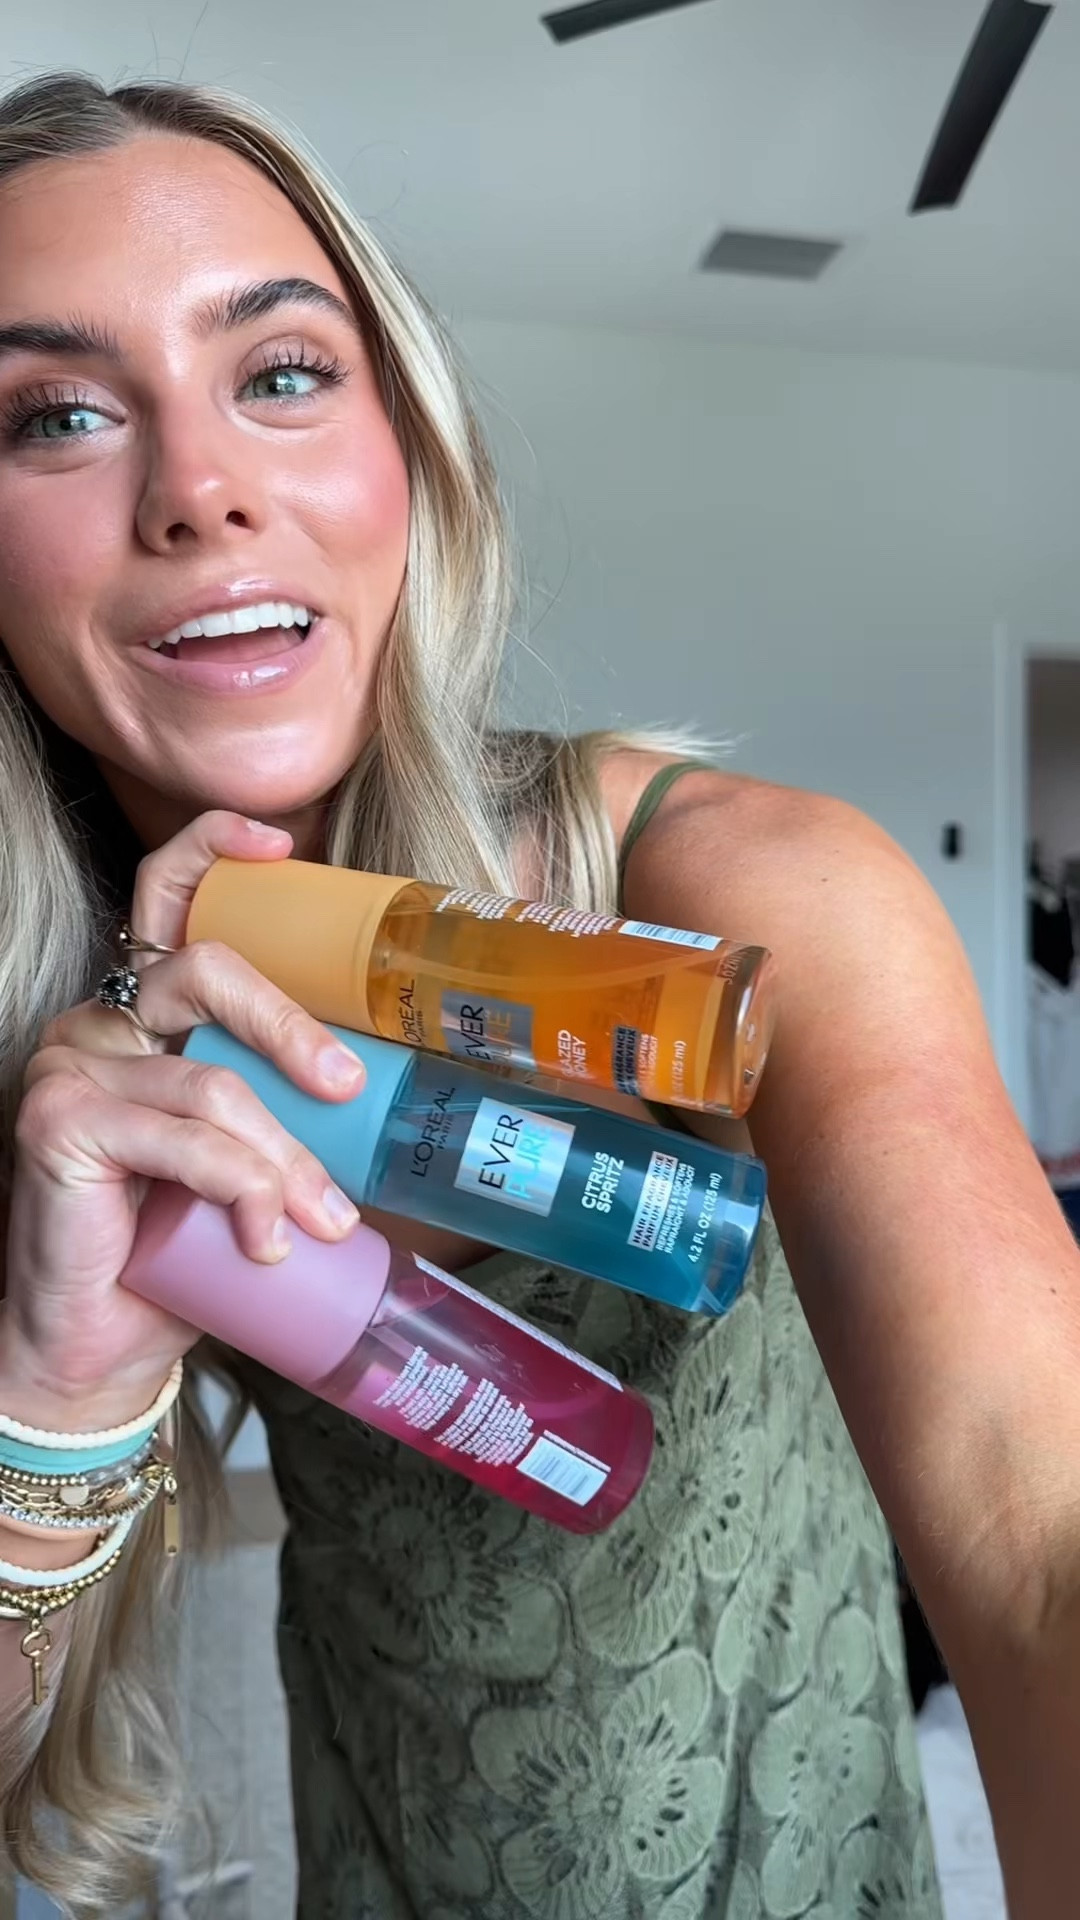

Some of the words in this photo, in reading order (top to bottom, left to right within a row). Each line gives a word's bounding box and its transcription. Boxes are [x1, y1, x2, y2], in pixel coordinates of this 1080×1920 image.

[460, 1004, 491, 1061] EVER
[478, 1114, 523, 1190] EVER
[505, 1122, 549, 1199] PURE
[581, 1151, 610, 1209] CITRUS
[596, 1156, 625, 1213] SPRITZ
[632, 1217, 648, 1244] HAIR
[642, 1154, 665, 1216] FRAGRANCE
[702, 1188, 719, 1211] (125
[709, 1172, 723, 1190] ml)
[641, 1204, 661, 1248] PARFUM
[692, 1230, 708, 1246] FL
[697, 1212, 712, 1229] OZ
[687, 1243, 704, 1262] 4.2
